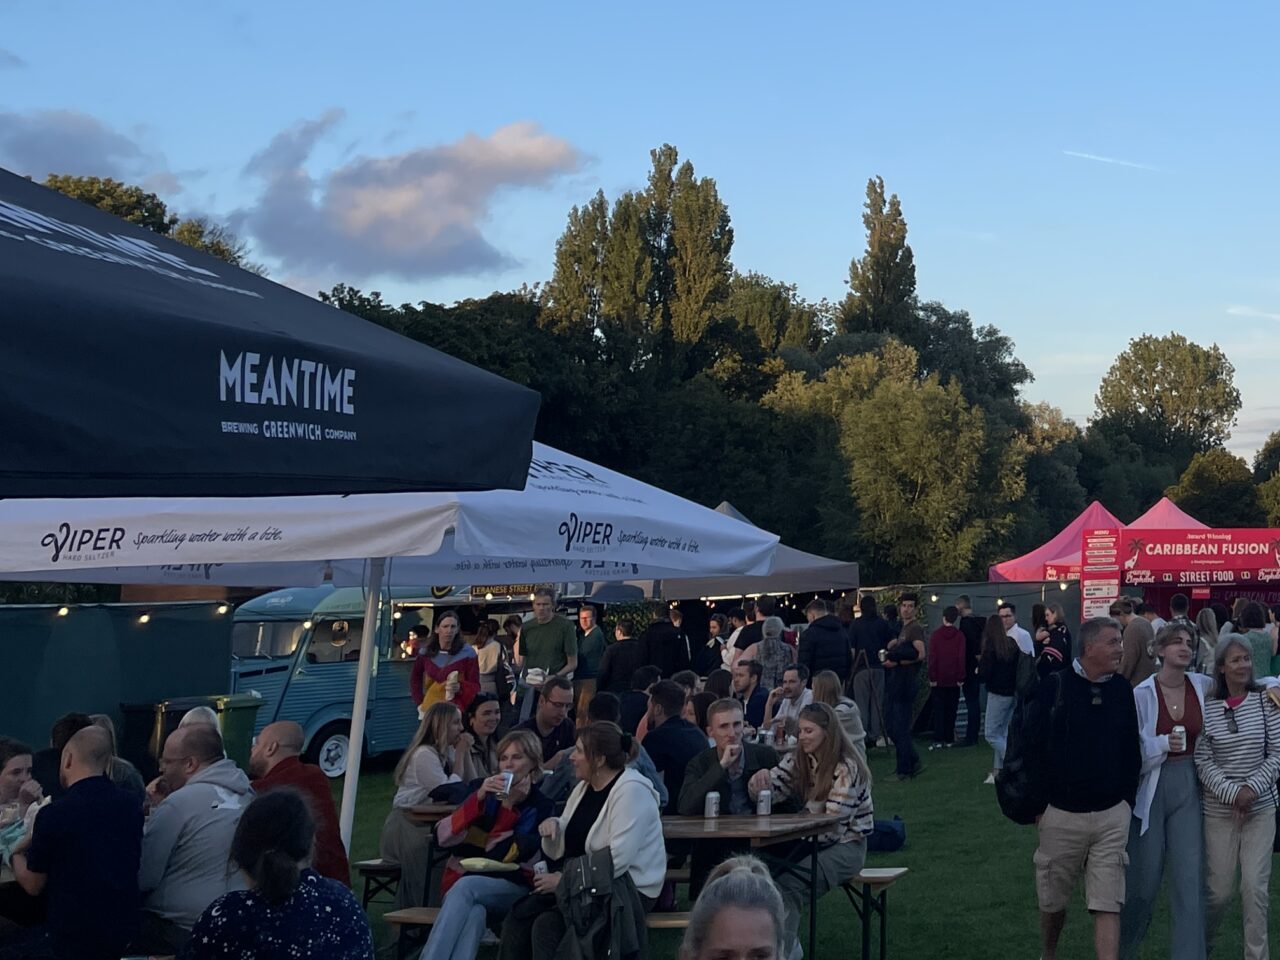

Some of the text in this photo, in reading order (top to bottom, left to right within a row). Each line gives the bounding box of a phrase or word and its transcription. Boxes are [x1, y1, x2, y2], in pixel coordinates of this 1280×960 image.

[220, 349, 356, 415] MEANTIME
[221, 420, 357, 441] BREWING GREENWICH COMPANY
[41, 522, 126, 563] VIPER
[132, 525, 283, 551] Sparkling water with a bite.
[558, 512, 614, 553] VIPER
[62, 550, 115, 561] HARD SELTZER
[1145, 542, 1269, 555] CARIBBEAN FUSION
[1180, 571, 1234, 583] STREET FOOD
[473, 586, 508, 594] LEBANESE
[509, 584, 533, 593] STREET
